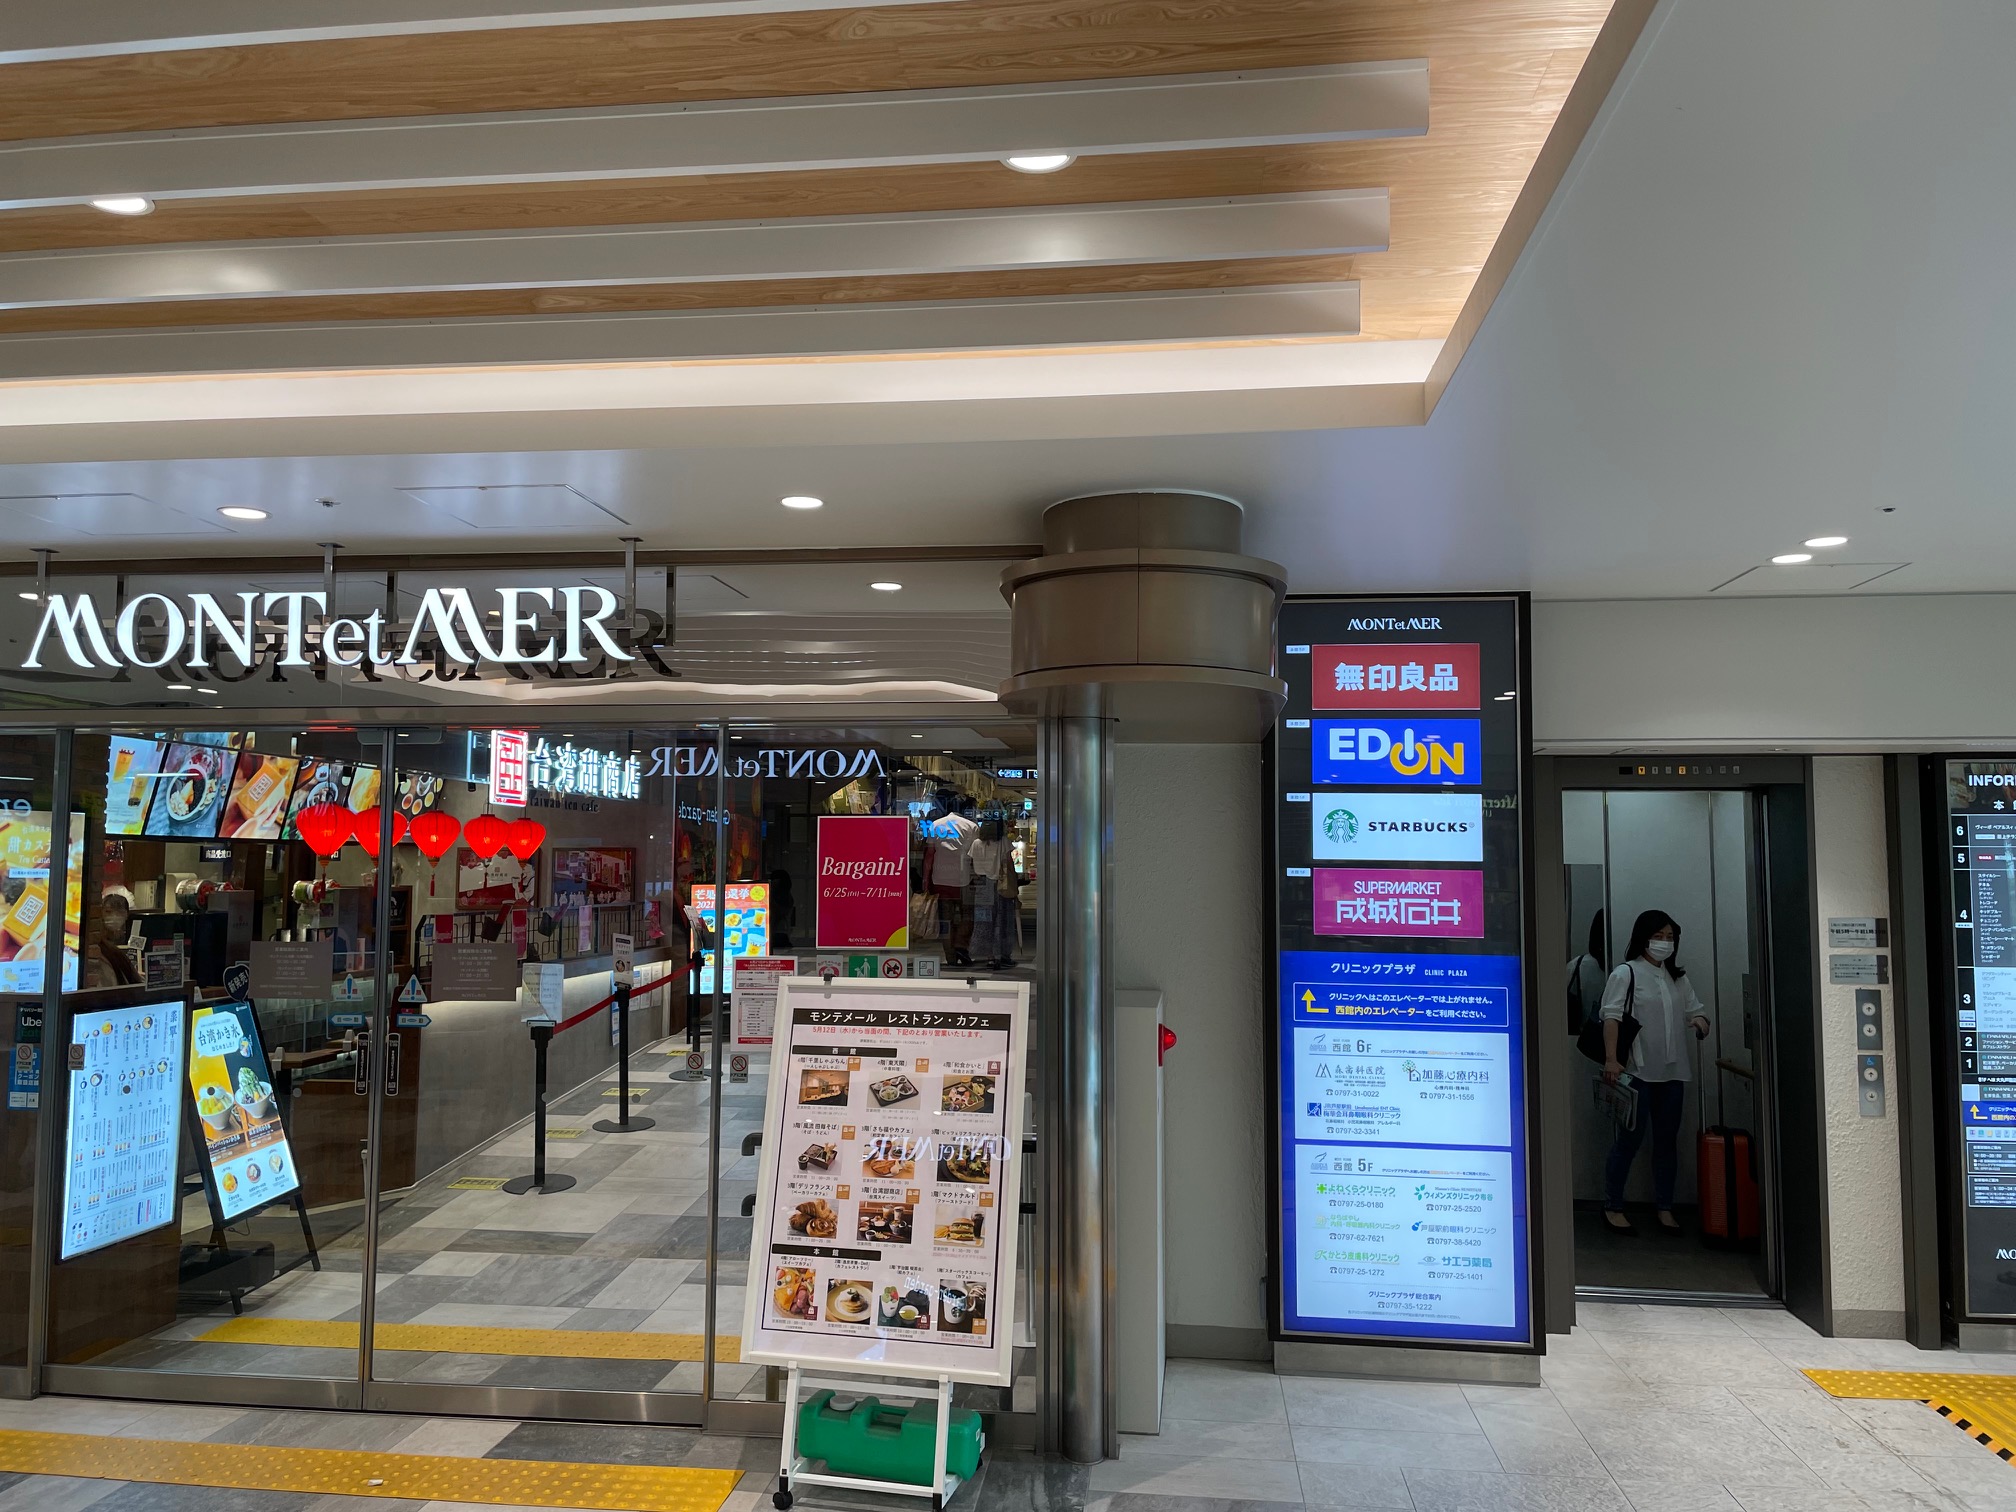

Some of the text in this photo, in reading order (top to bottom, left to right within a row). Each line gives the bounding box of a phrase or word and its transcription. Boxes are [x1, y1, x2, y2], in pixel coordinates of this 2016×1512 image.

[1335, 662, 1459, 692] 無印良品
[1329, 728, 1464, 776] EDION
[529, 737, 642, 800] 台湾甜商店
[1968, 774, 2016, 787] INFOR
[1956, 825, 1964, 836] 6
[1957, 853, 1965, 863] 5
[822, 856, 905, 880] Bargain!
[1354, 881, 1442, 895] SUPERMARKET
[694, 888, 750, 900] 芒果選挙
[695, 900, 715, 909] 2021
[1336, 898, 1462, 925] 成城石井
[1959, 909, 1967, 919] 4
[1330, 963, 1468, 977] クリニックプラザ CLINIC PLAZA
[1329, 992, 1493, 1005] クリニックへはこのエレベーターでは上がれません。
[1963, 993, 1971, 1004] 3
[22, 1016, 42, 1027] Ube
[809, 1011, 990, 1027] モンテメール レストラン・カフェ
[198, 1023, 240, 1046] 台湾かき氷
[1332, 1043, 1351, 1052] 西館
[1356, 1039, 1372, 1053] 6F
[1965, 1036, 1973, 1047] 2
[1965, 1058, 1972, 1069] 1
[1422, 1068, 1489, 1081] 加藤心療内科
[1334, 1089, 1380, 1098] 0797-31-0022
[1335, 1127, 1380, 1135] 0797-32-3341
[1333, 1158, 1373, 1172] 西館 5F
[1328, 1184, 1396, 1194] よねくらクリニック
[1337, 1200, 1384, 1208] 0797-25-0180
[1434, 1204, 1482, 1212] 0797-25-2520
[1337, 1233, 1384, 1242] 0797-62-7621
[1435, 1238, 1482, 1246] 0797-38-5420
[1337, 1267, 1385, 1276] 0797-25-1272
[1436, 1271, 1483, 1280] 0797-25-1401
[1385, 1301, 1433, 1310] 0797-35-1222
